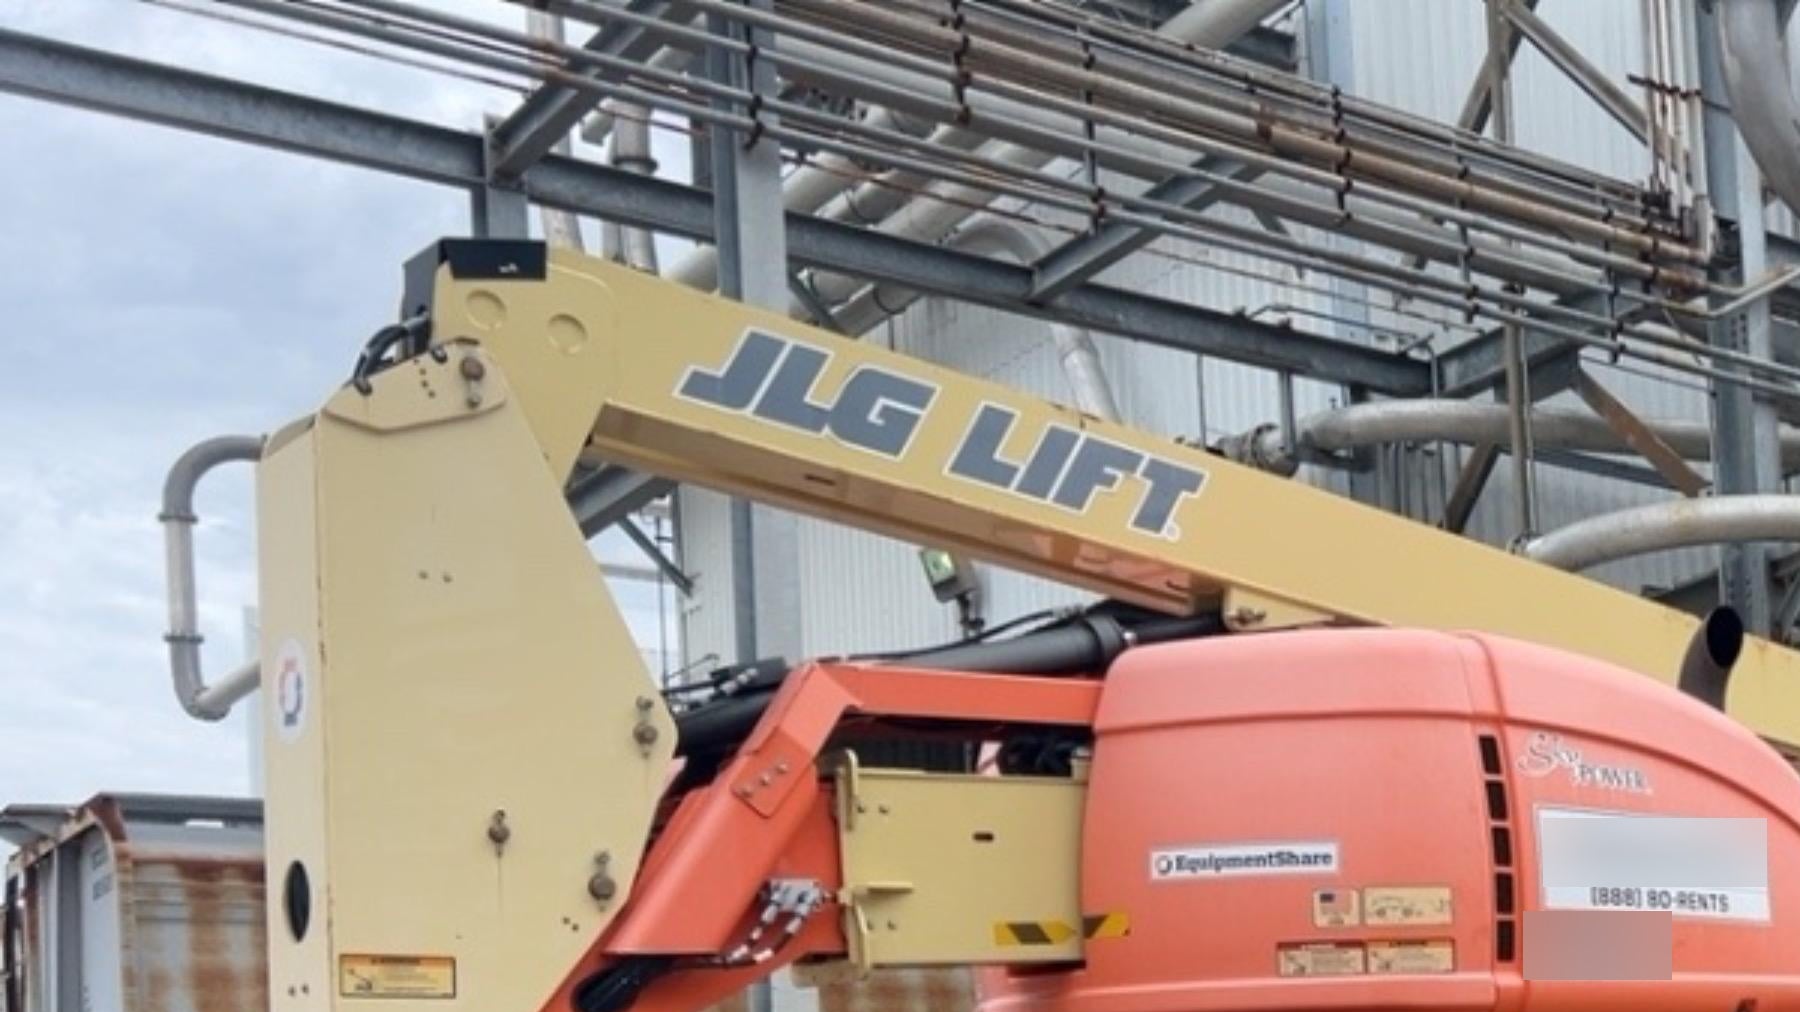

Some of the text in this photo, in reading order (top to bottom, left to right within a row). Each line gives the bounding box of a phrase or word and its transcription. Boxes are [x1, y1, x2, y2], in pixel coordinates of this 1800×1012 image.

[672, 326, 1209, 540] JLG LIFT
[1175, 850, 1334, 874] EquipmentShare
